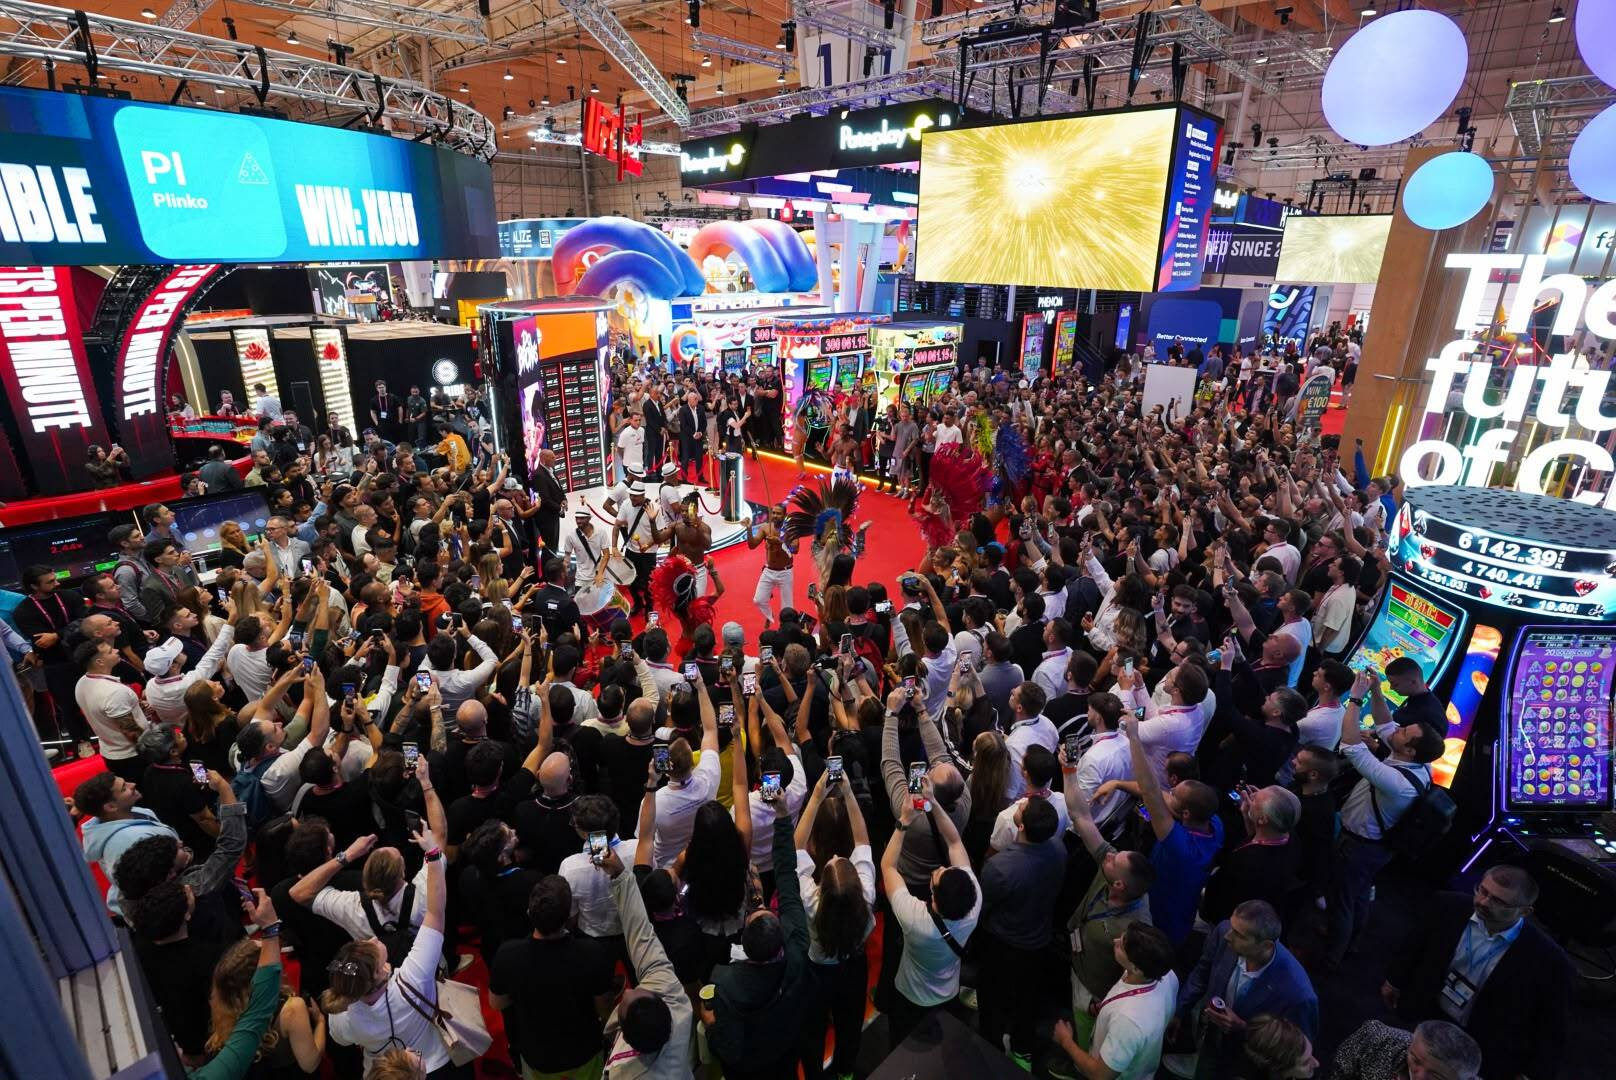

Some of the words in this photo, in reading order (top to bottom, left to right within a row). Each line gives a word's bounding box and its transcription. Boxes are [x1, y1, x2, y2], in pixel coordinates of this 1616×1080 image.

[0, 162, 107, 243] BLE
[152, 192, 209, 208] Plinko
[1230, 241, 1274, 257] SINCE
[0, 295, 67, 338] PER
[135, 290, 189, 330] PER
[1042, 310, 1055, 324] VIP
[1156, 332, 1175, 342] Better
[1175, 334, 1208, 344] Connected
[6, 340, 93, 433] MINUTE
[122, 330, 164, 420] MINUTE
[1400, 428, 1519, 489] of
[1478, 537, 1558, 568] 142.39
[1476, 565, 1537, 589] 740.44
